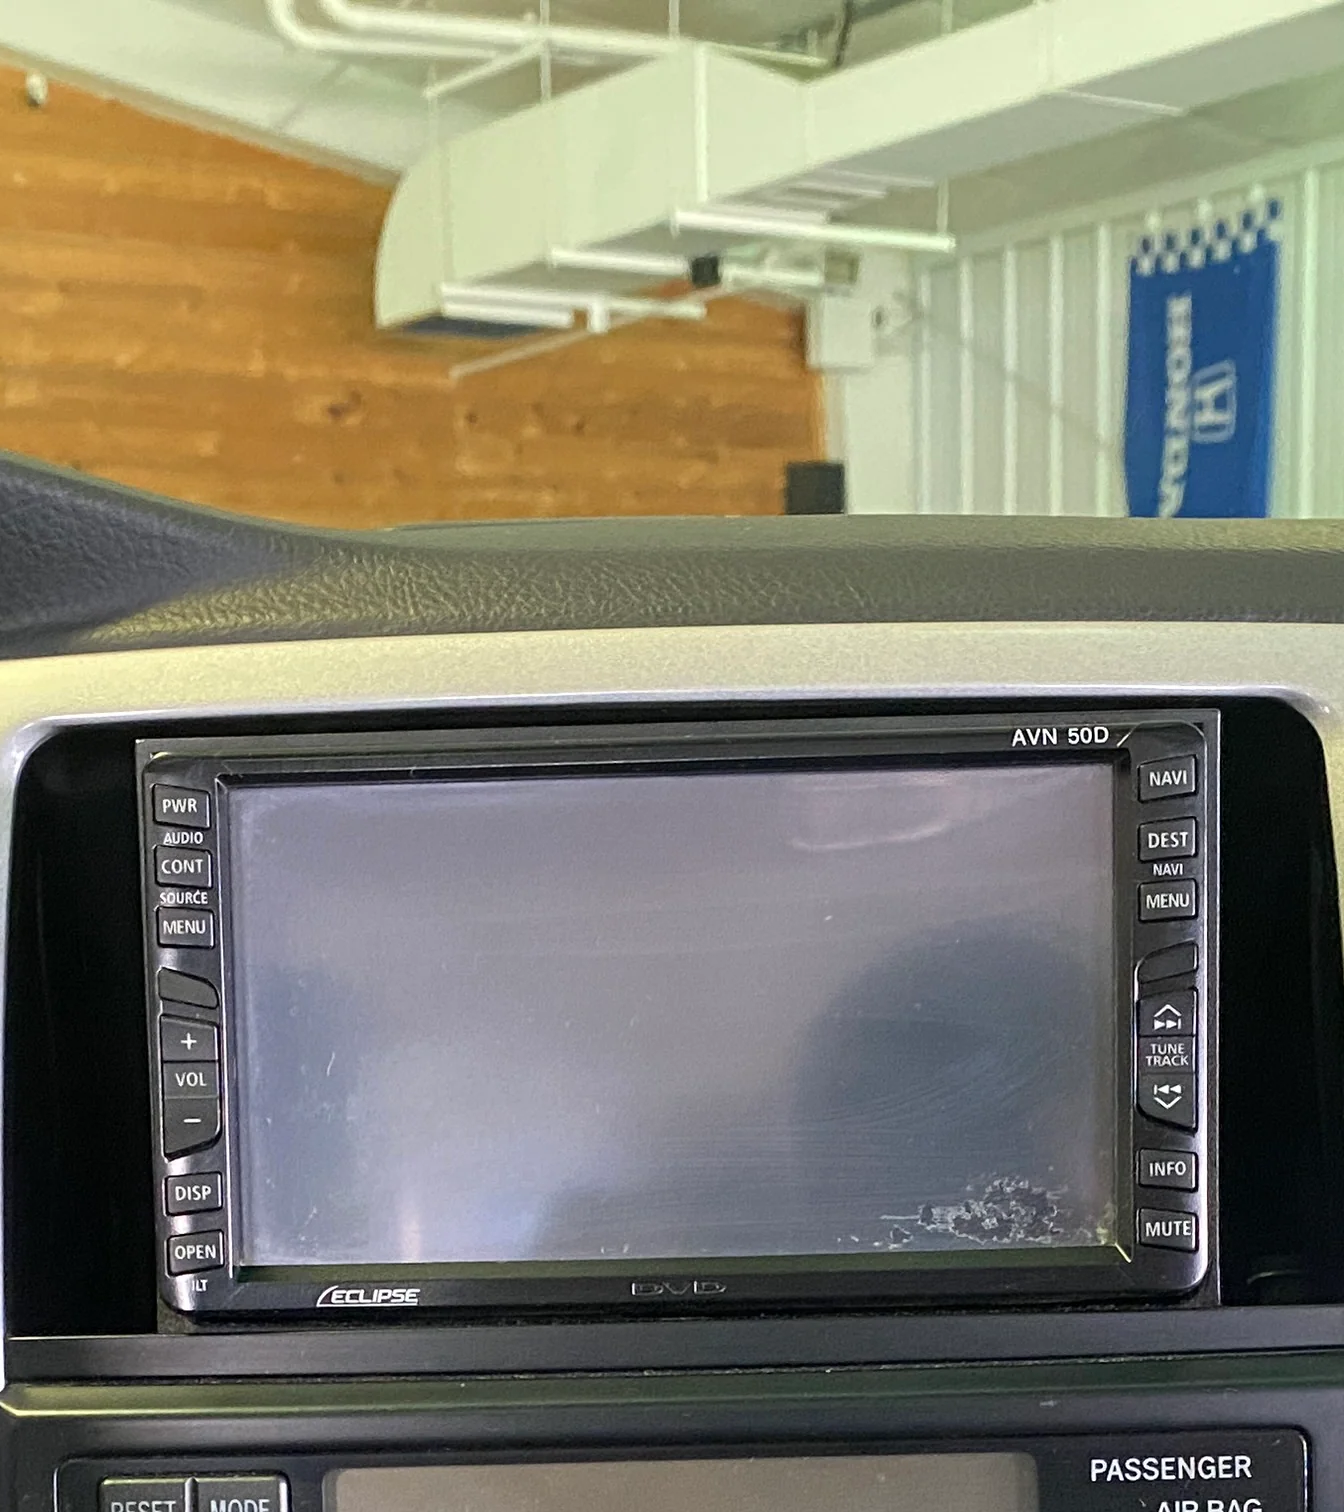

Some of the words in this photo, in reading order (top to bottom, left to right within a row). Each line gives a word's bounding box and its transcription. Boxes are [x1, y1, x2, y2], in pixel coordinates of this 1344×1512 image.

[1012, 728, 1058, 746] AVN
[1067, 726, 1110, 745] 50D
[1149, 770, 1188, 787] NAVI
[162, 799, 197, 814] PWR
[163, 831, 204, 845] AUDIO
[1148, 832, 1188, 849] DEST
[161, 858, 203, 875] CONT
[1153, 862, 1184, 877] NAVI
[159, 889, 208, 904] SOURCE
[1145, 892, 1189, 910] MENU
[163, 919, 206, 936] MENU
[1150, 1043, 1185, 1056] TUNE
[1145, 1054, 1189, 1068] TRACK
[175, 1072, 207, 1088] VOL
[1149, 1160, 1187, 1178] INFO
[175, 1185, 211, 1201] DISP
[1145, 1220, 1192, 1239] MUTE
[174, 1243, 217, 1261] OPEN
[186, 1279, 208, 1292] ILT
[331, 1288, 421, 1304] ECLIPSE
[1090, 1455, 1252, 1482] PASSENGER
